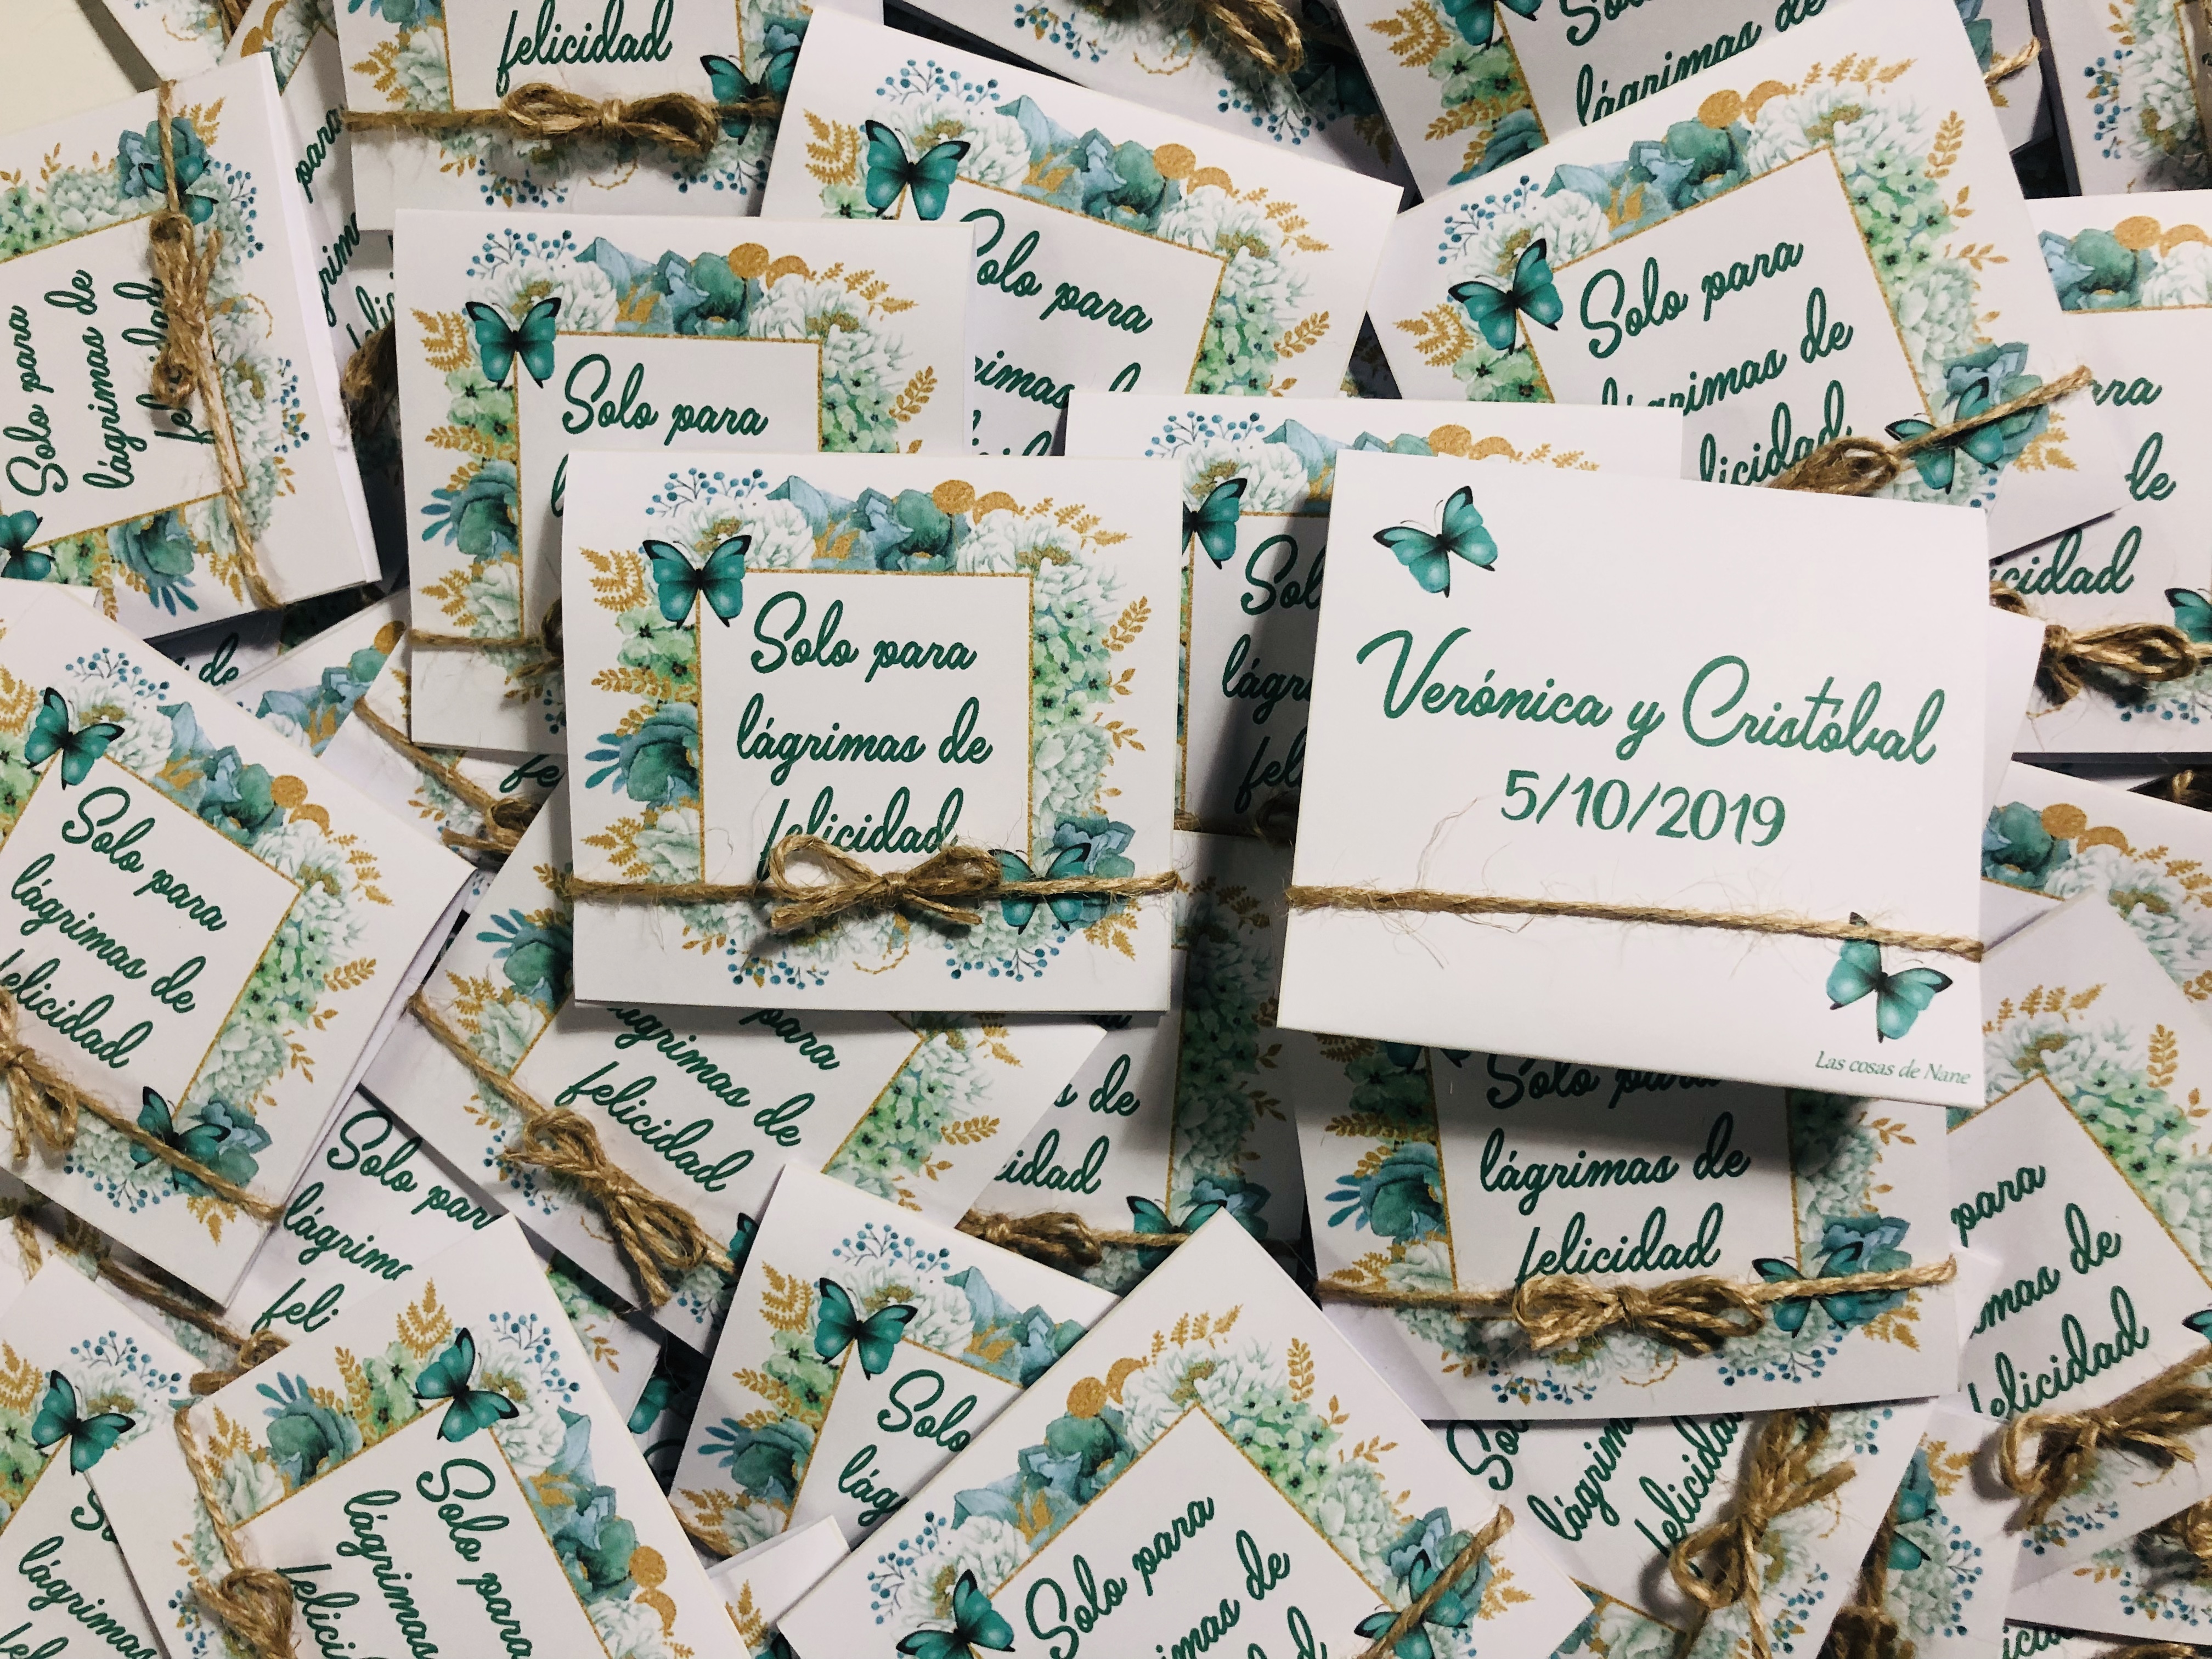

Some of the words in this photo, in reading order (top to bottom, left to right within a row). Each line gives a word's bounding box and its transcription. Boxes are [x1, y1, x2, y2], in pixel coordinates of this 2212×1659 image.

[496, 0, 673, 98] felicidad
[44, 269, 97, 315] de
[1039, 282, 1153, 334] para
[1580, 257, 1689, 359] Solo
[1701, 241, 1804, 321] para
[1800, 287, 1853, 363] de
[12, 305, 54, 393] para
[82, 326, 147, 489] lágrimas
[562, 354, 659, 435] Solo
[663, 401, 768, 446] para
[3, 404, 68, 496] Solo
[751, 591, 859, 674] Solo
[865, 640, 978, 683] para
[737, 693, 926, 786] lágrimas
[938, 697, 993, 764] de
[1356, 627, 1613, 727] Verónica
[1615, 700, 1666, 761] y
[1682, 654, 1945, 765] Cristóbal
[1501, 769, 1786, 847] 5/10/2019
[61, 787, 156, 873] Solo
[133, 869, 227, 932] para
[11, 853, 147, 979] lágrimas
[151, 956, 206, 1014] de
[1089, 1053, 1140, 1116] de
[1815, 1050, 1846, 1070] Las
[1848, 1059, 1895, 1076] cosas
[1898, 1058, 1921, 1079] de
[1923, 1063, 1971, 1085] Nane
[555, 1060, 755, 1192] felicidad
[754, 1092, 815, 1147] de
[1480, 1127, 1679, 1216] lágrimas
[1692, 1111, 1750, 1180] de
[327, 1110, 424, 1193] Solo
[411, 1185, 504, 1231] par
[1950, 1164, 2047, 1248] para
[2065, 1203, 2122, 1275] de
[877, 1369, 977, 1452] Solo
[416, 1458, 510, 1562] Solo
[336, 1489, 439, 1659] lágrimas
[1025, 1554, 1127, 1659] Solo
[1132, 1496, 1215, 1596] para
[1235, 1529, 1290, 1601] de
[456, 1572, 533, 1659] para
